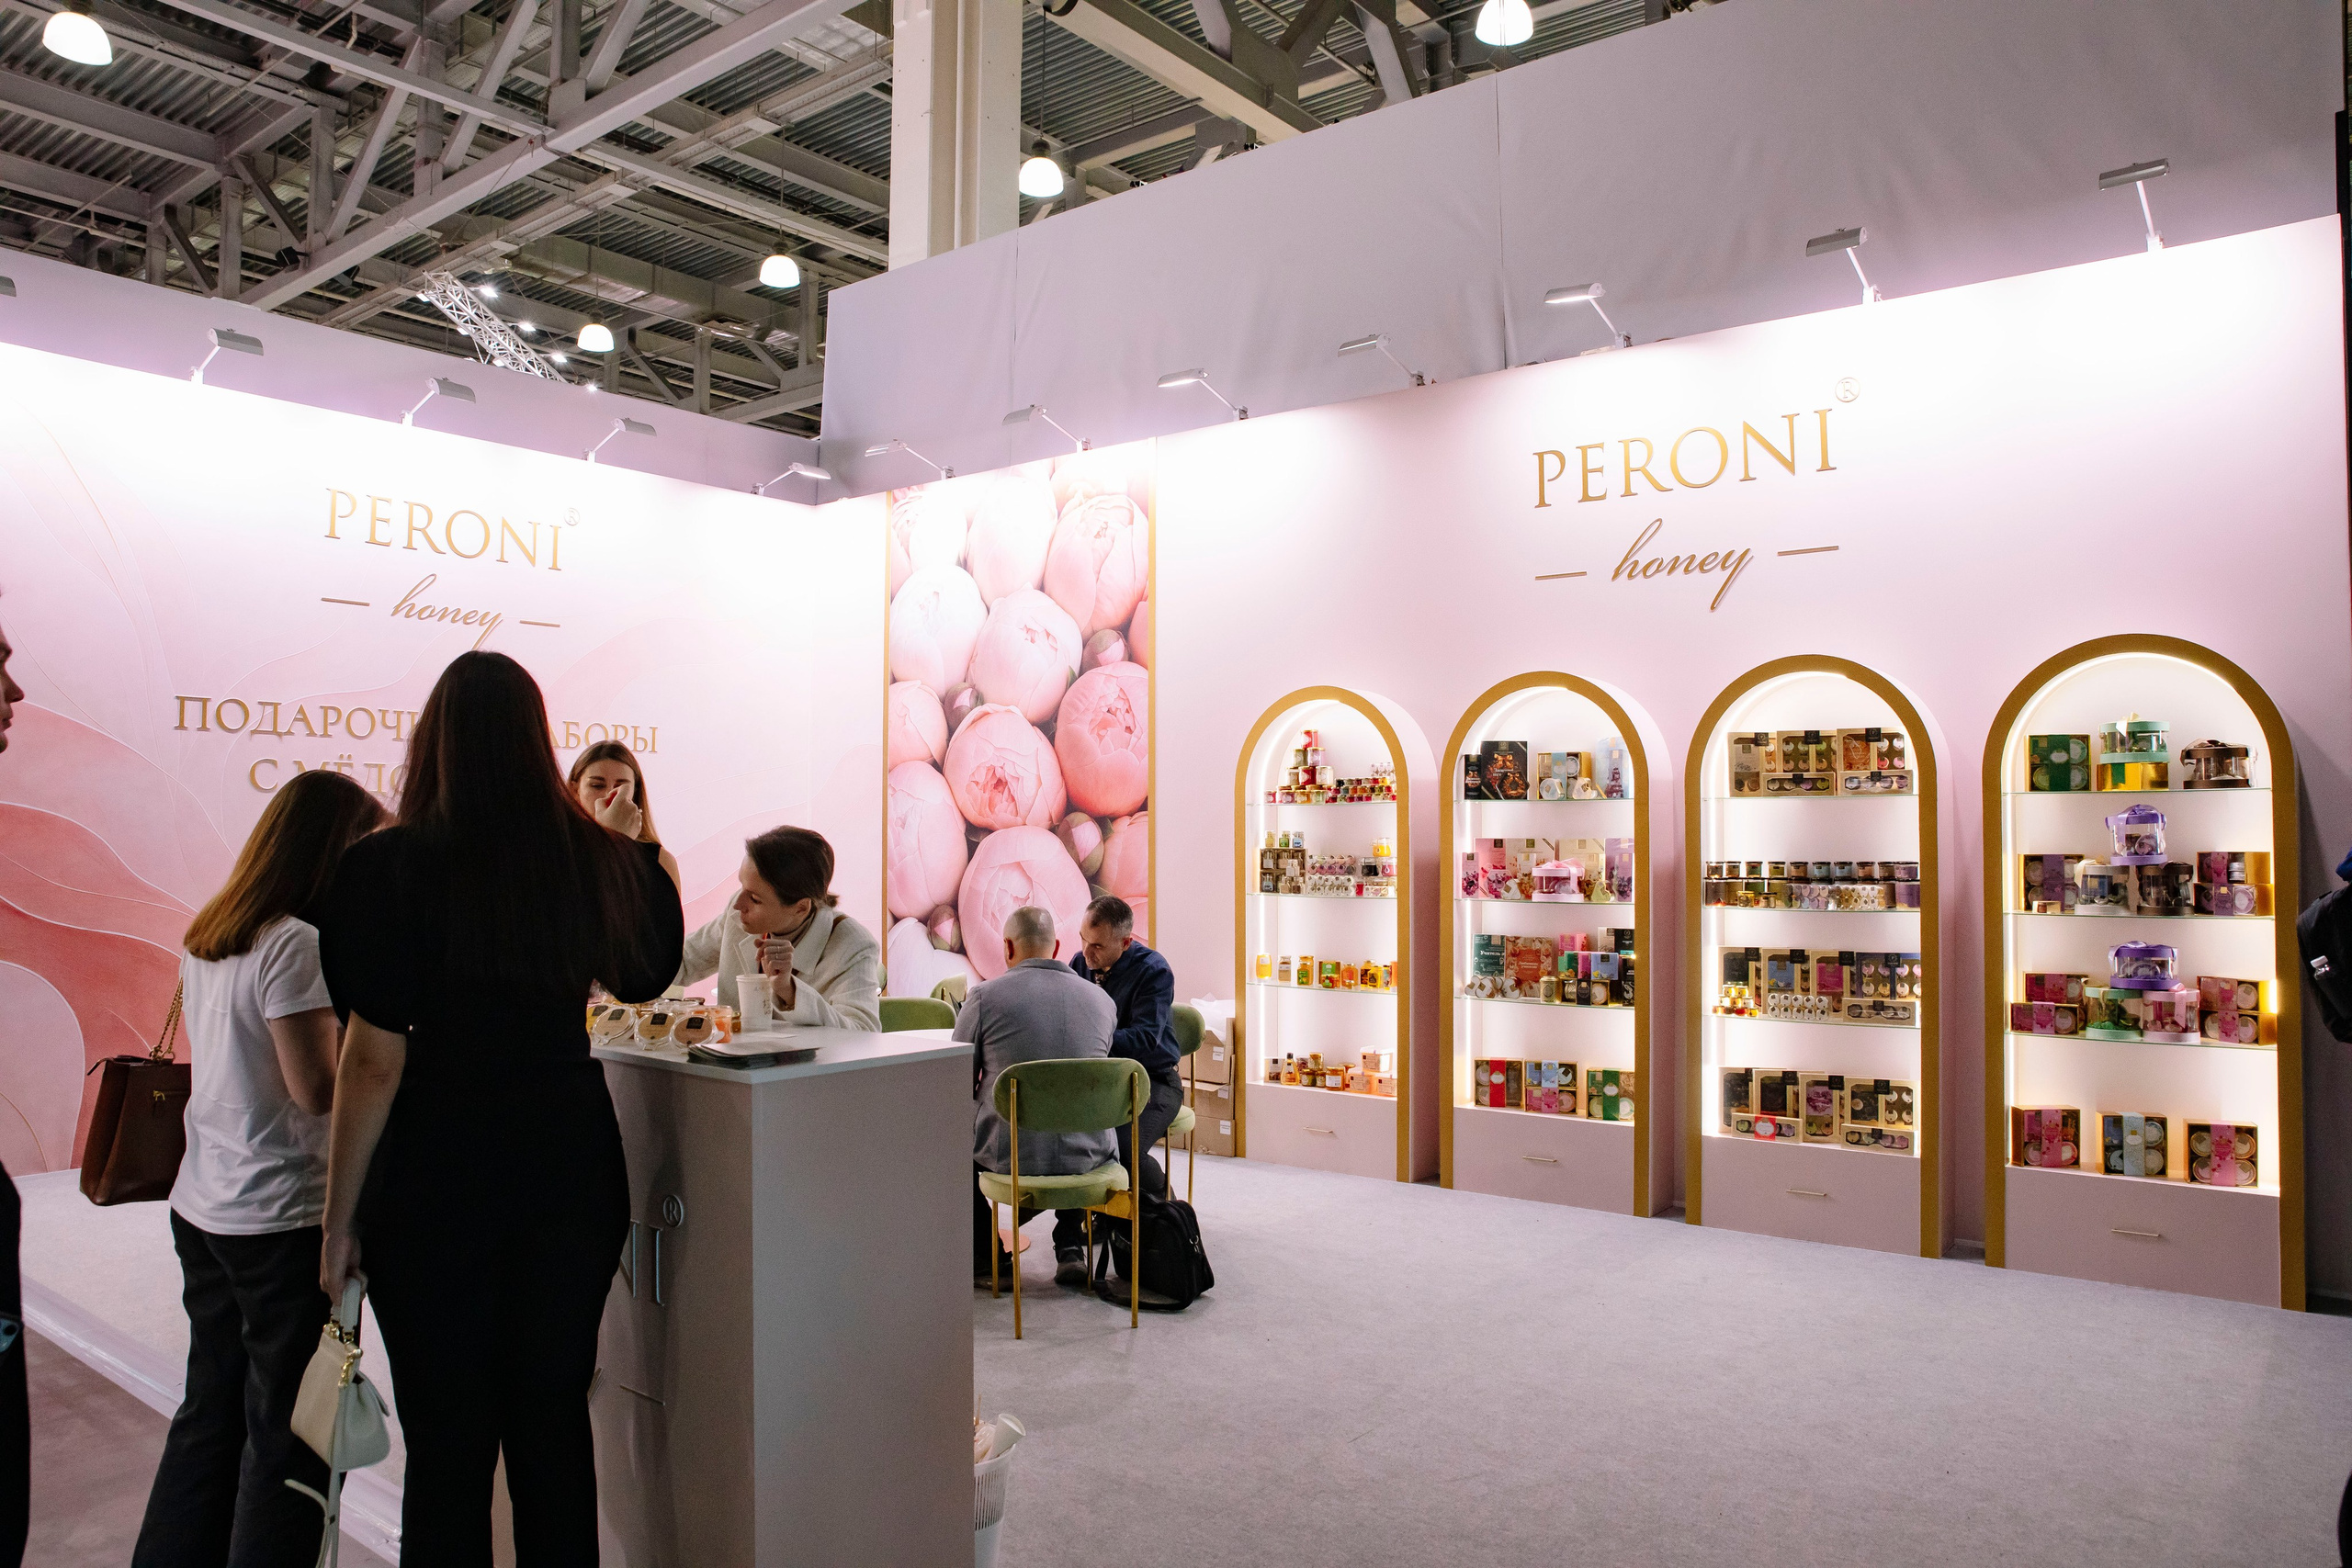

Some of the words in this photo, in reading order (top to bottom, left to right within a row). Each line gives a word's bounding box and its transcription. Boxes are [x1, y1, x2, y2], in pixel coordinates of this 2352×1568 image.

[1611, 517, 1754, 613] honey
[390, 573, 503, 650] honey
[174, 695, 419, 742] ПОДАРОЧ
[548, 720, 659, 753] АБОРЫ
[249, 758, 279, 793] С
